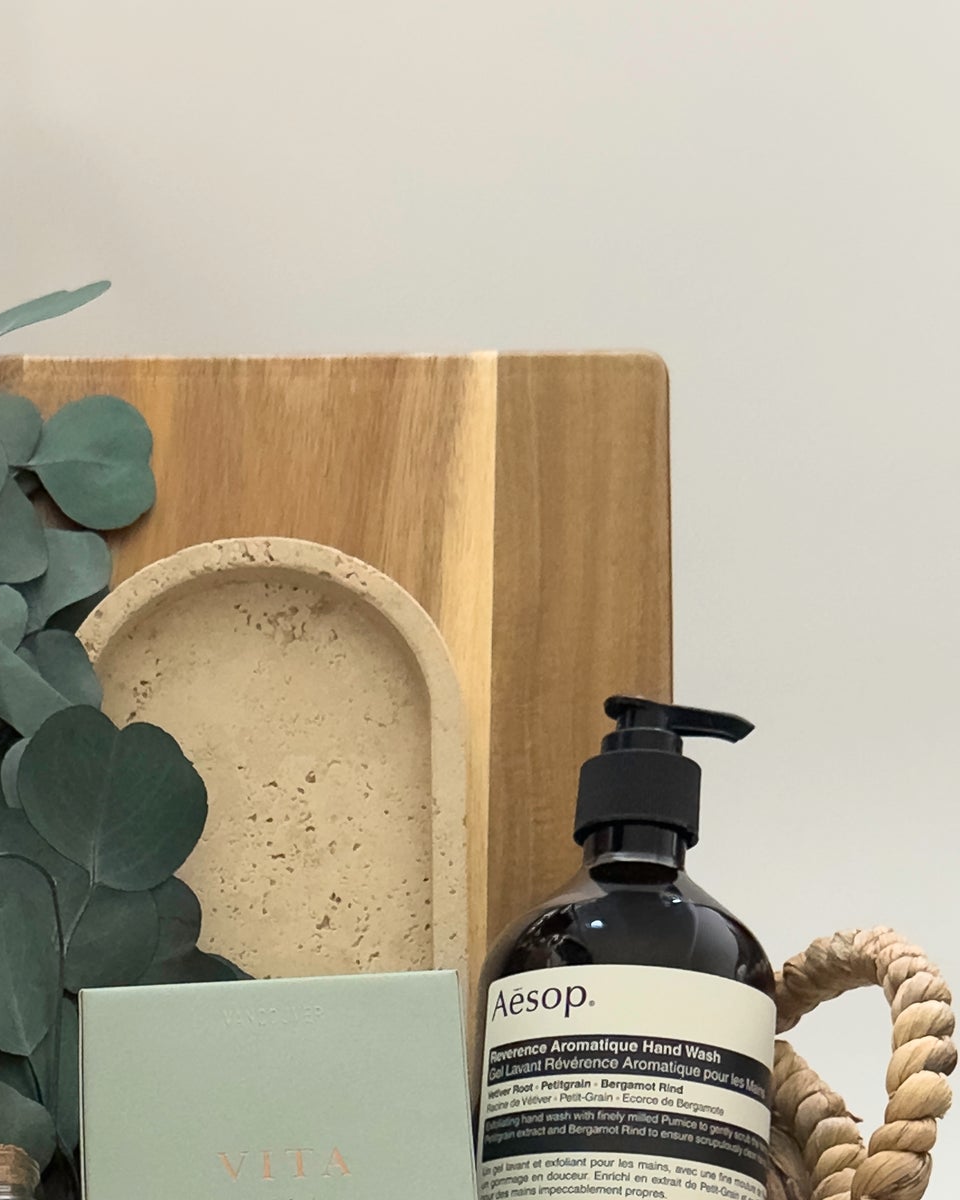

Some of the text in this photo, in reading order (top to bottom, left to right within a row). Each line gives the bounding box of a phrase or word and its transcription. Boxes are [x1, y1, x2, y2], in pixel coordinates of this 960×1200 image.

[489, 1038, 721, 1064] Reverence Aromatique Hand Wash
[488, 1065, 503, 1080] Gel
[505, 1060, 541, 1077] Lavant
[544, 1056, 619, 1071] Révérence
[622, 1056, 700, 1077] Aromatique
[703, 1067, 729, 1082] pour
[512, 1083, 533, 1095] Root
[541, 1079, 591, 1092] Petitgrain
[601, 1079, 656, 1091] Bergamot
[658, 1081, 684, 1095] Rind
[559, 1092, 613, 1103] Petit-Grain
[661, 1095, 674, 1106] de
[676, 1097, 725, 1117] Bergamote
[521, 1113, 544, 1124] hand
[545, 1111, 571, 1122] wash
[573, 1110, 594, 1121] with
[597, 1110, 626, 1124] finely
[628, 1112, 659, 1124] milled
[661, 1114, 697, 1129] Pumice
[699, 1121, 708, 1131] to
[547, 1124, 566, 1136] and
[568, 1124, 619, 1137] Bergamot
[621, 1124, 646, 1136] Rind
[648, 1126, 658, 1137] to
[660, 1130, 694, 1142] ensure
[217, 1146, 352, 1183] VITA
[533, 1159, 542, 1168] et
[545, 1158, 586, 1168] exfoliant
[590, 1159, 614, 1170] pour
[618, 1159, 634, 1168] les
[637, 1160, 671, 1174] mains,
[675, 1165, 697, 1176] avec
[700, 1170, 716, 1180] une
[491, 1174, 529, 1189] gommage
[531, 1173, 543, 1182] en
[594, 1170, 631, 1181] Enrichi
[634, 1175, 647, 1183] en
[651, 1177, 681, 1187] extrait
[685, 1180, 697, 1190] de
[511, 1186, 536, 1197] mains
[538, 1184, 622, 1196] impeccablement
[625, 1187, 667, 1199] propres.
